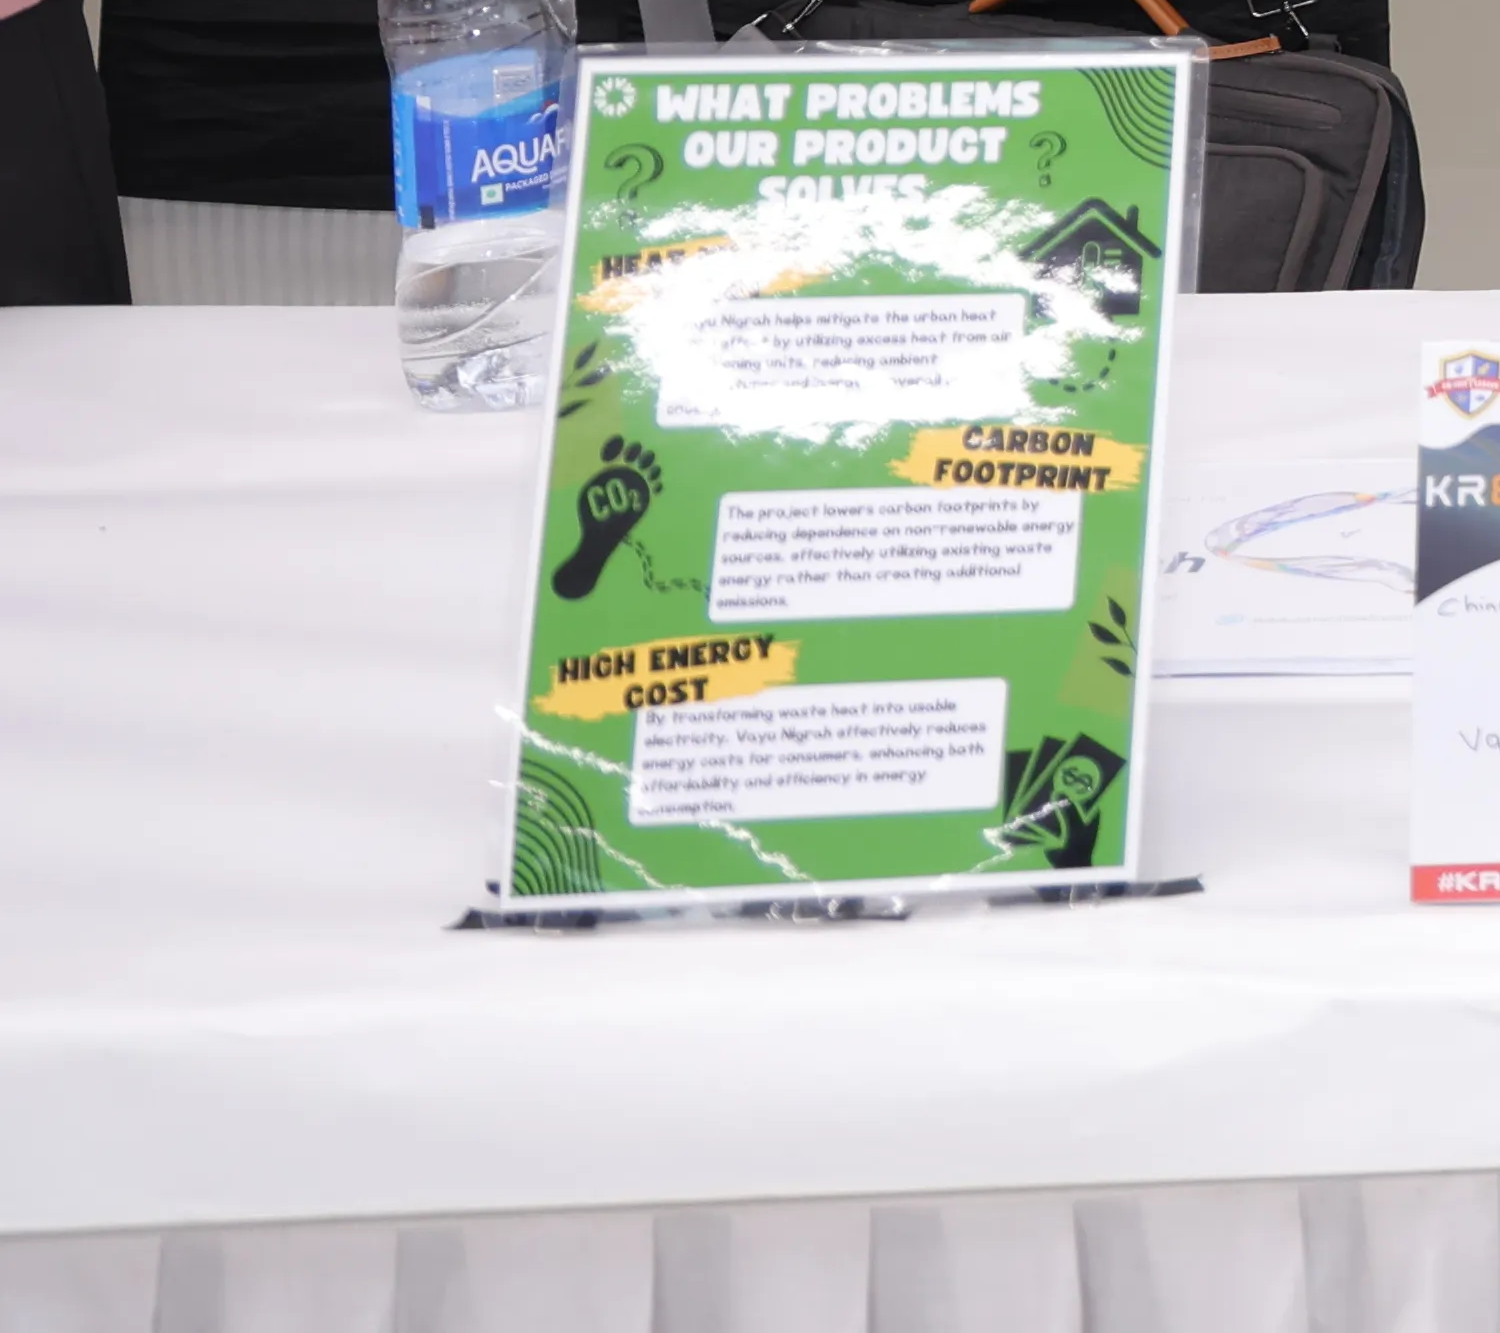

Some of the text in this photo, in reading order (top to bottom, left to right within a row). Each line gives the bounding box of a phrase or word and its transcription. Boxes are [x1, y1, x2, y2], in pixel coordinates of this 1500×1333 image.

[656, 81, 1041, 121] WHAT PROBLEMS
[683, 127, 1008, 167] OUR PRODUCT
[962, 425, 1096, 455] CARBON
[933, 459, 1111, 489] FOOTPRINT
[728, 498, 1039, 521] The project lowers carbon footprints by
[557, 630, 779, 681] HIGH ENERGY
[623, 675, 710, 709] COST
